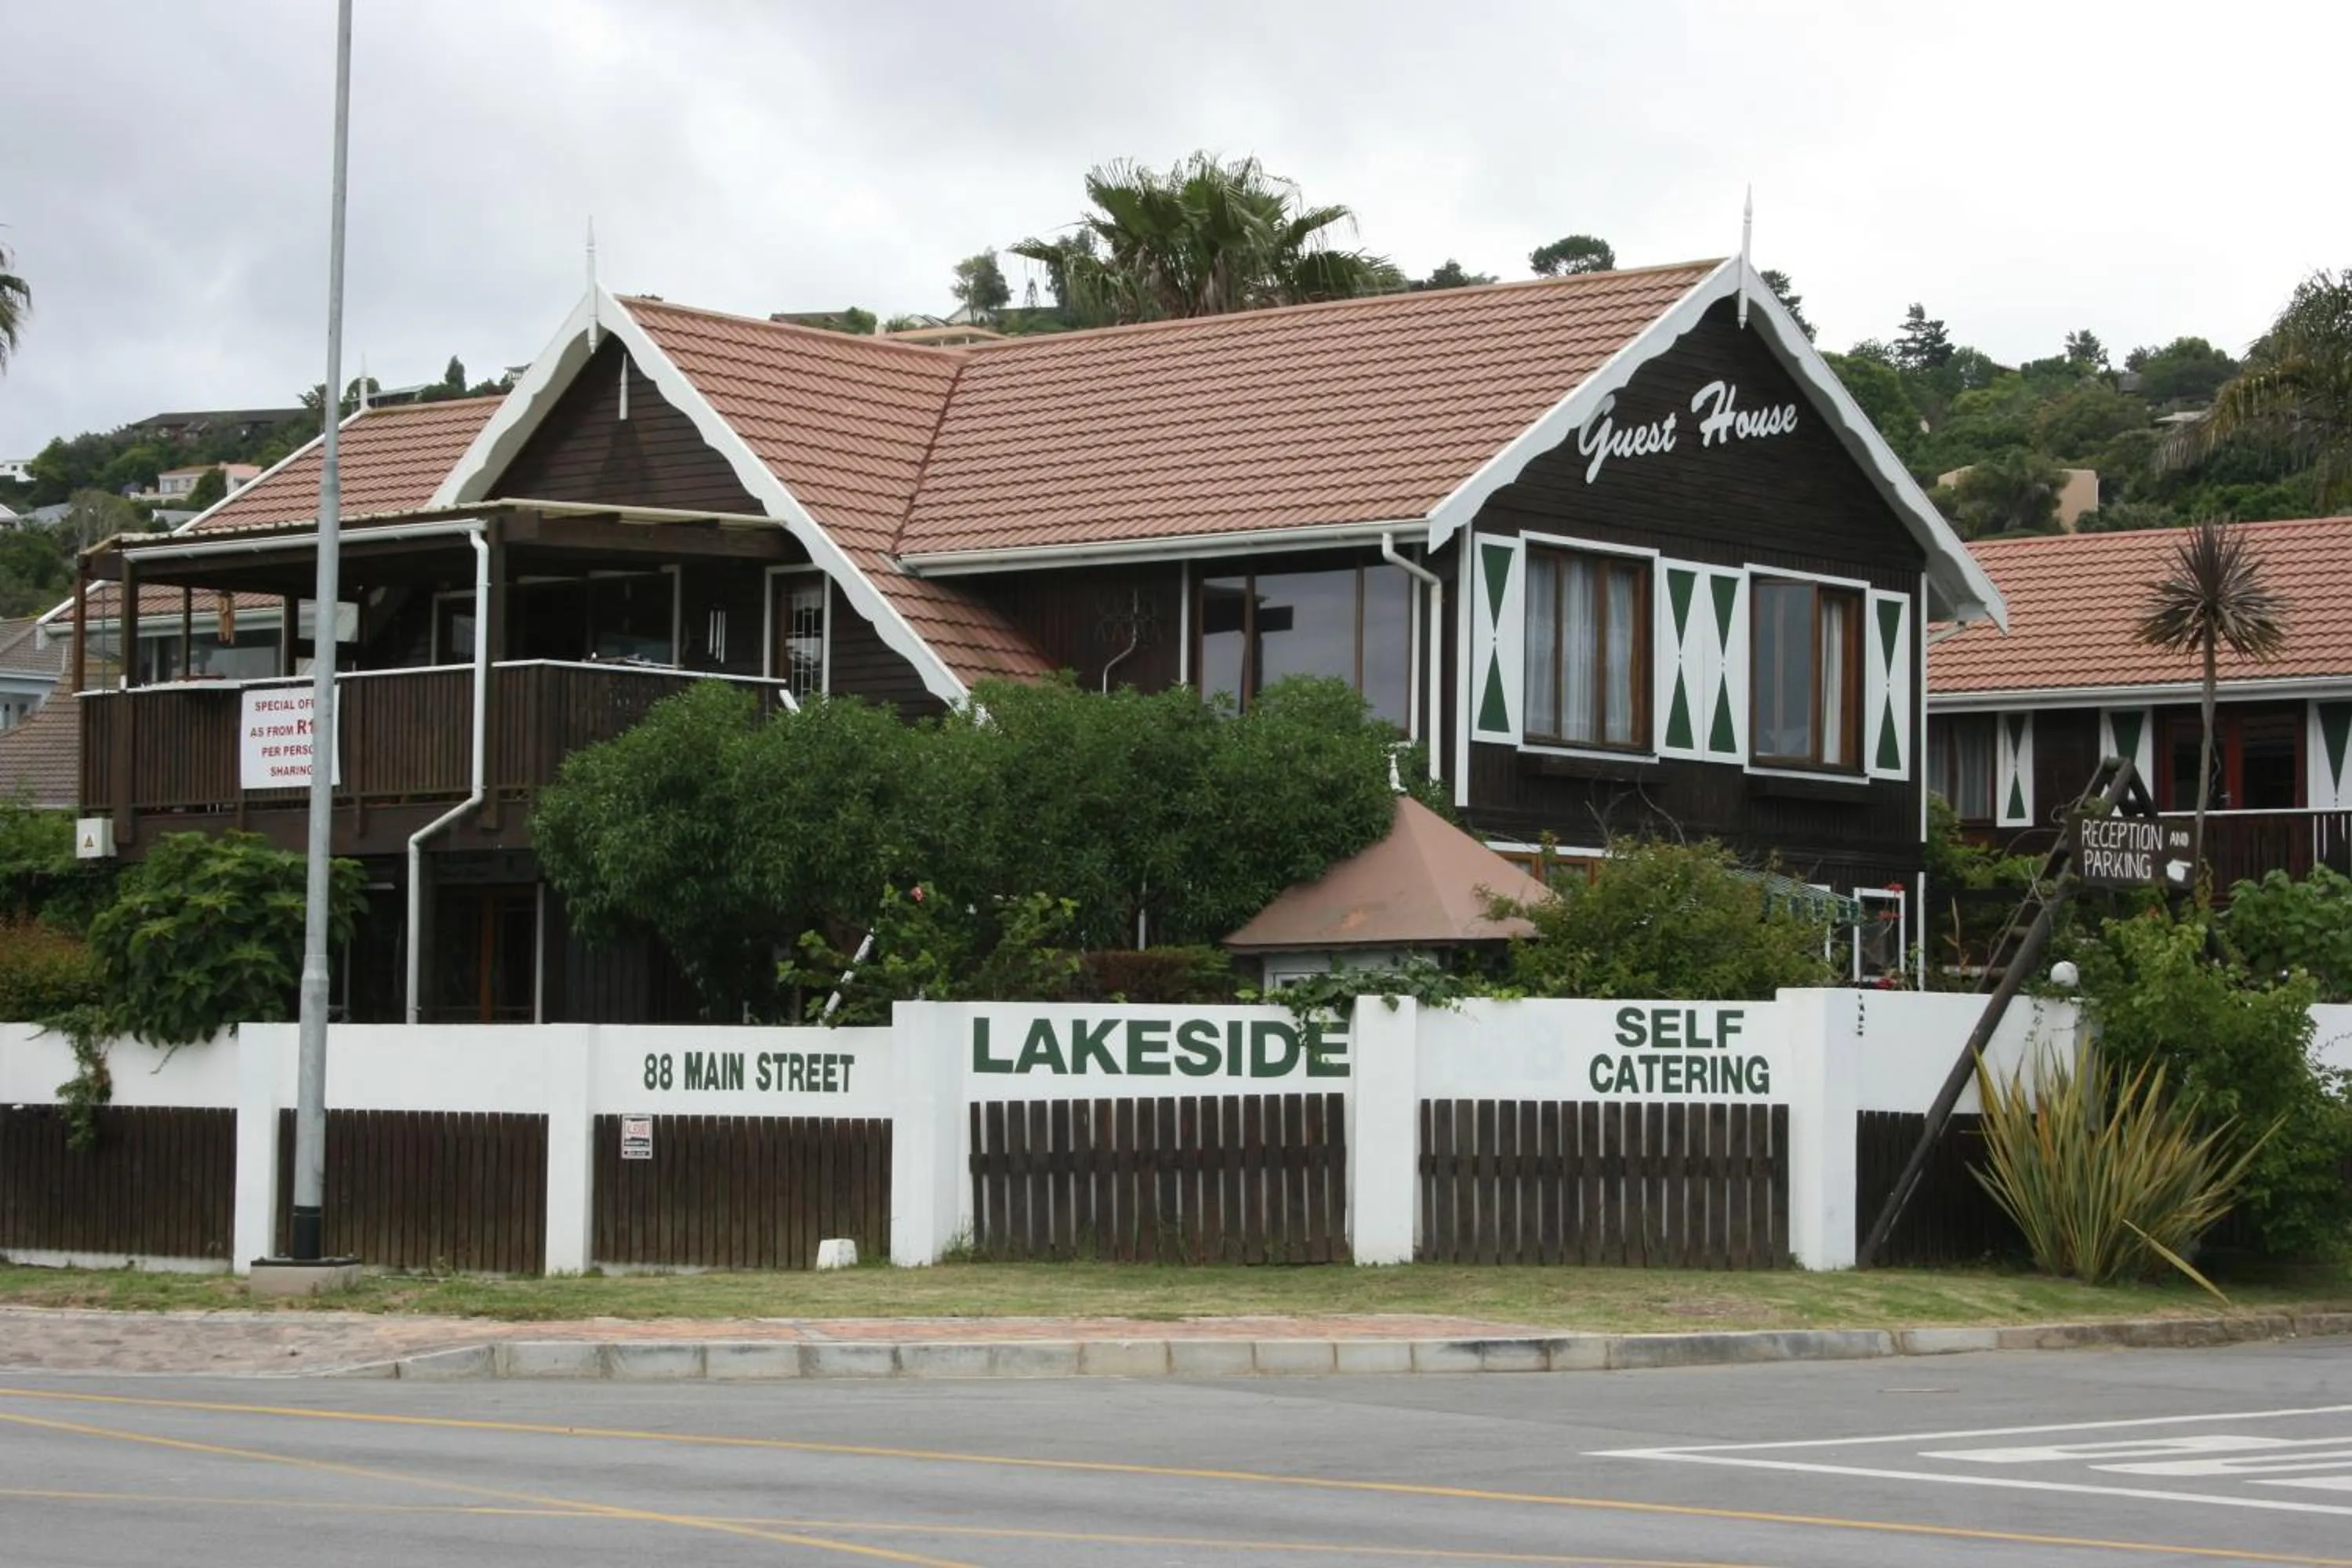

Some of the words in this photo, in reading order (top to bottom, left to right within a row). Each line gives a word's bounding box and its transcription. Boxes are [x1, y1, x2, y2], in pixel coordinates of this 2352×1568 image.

[1578, 393, 1677, 484] Guest
[1691, 380, 1798, 448] House
[255, 701, 295, 711] SPECIAL
[250, 727, 264, 738] AS
[267, 725, 294, 737] FROM
[261, 747, 281, 757] PER
[283, 745, 314, 756] PERSO
[2082, 819, 2163, 851] RECEPTION
[2170, 831, 2190, 848] AND
[2084, 850, 2152, 879] PARKING
[1615, 1007, 1744, 1048] SELF
[973, 1017, 1351, 1077] LAKESIDE
[644, 1053, 673, 1091] 88
[684, 1051, 744, 1091] MAIN
[755, 1051, 855, 1093] STREET
[1589, 1053, 1769, 1094] CATERING
